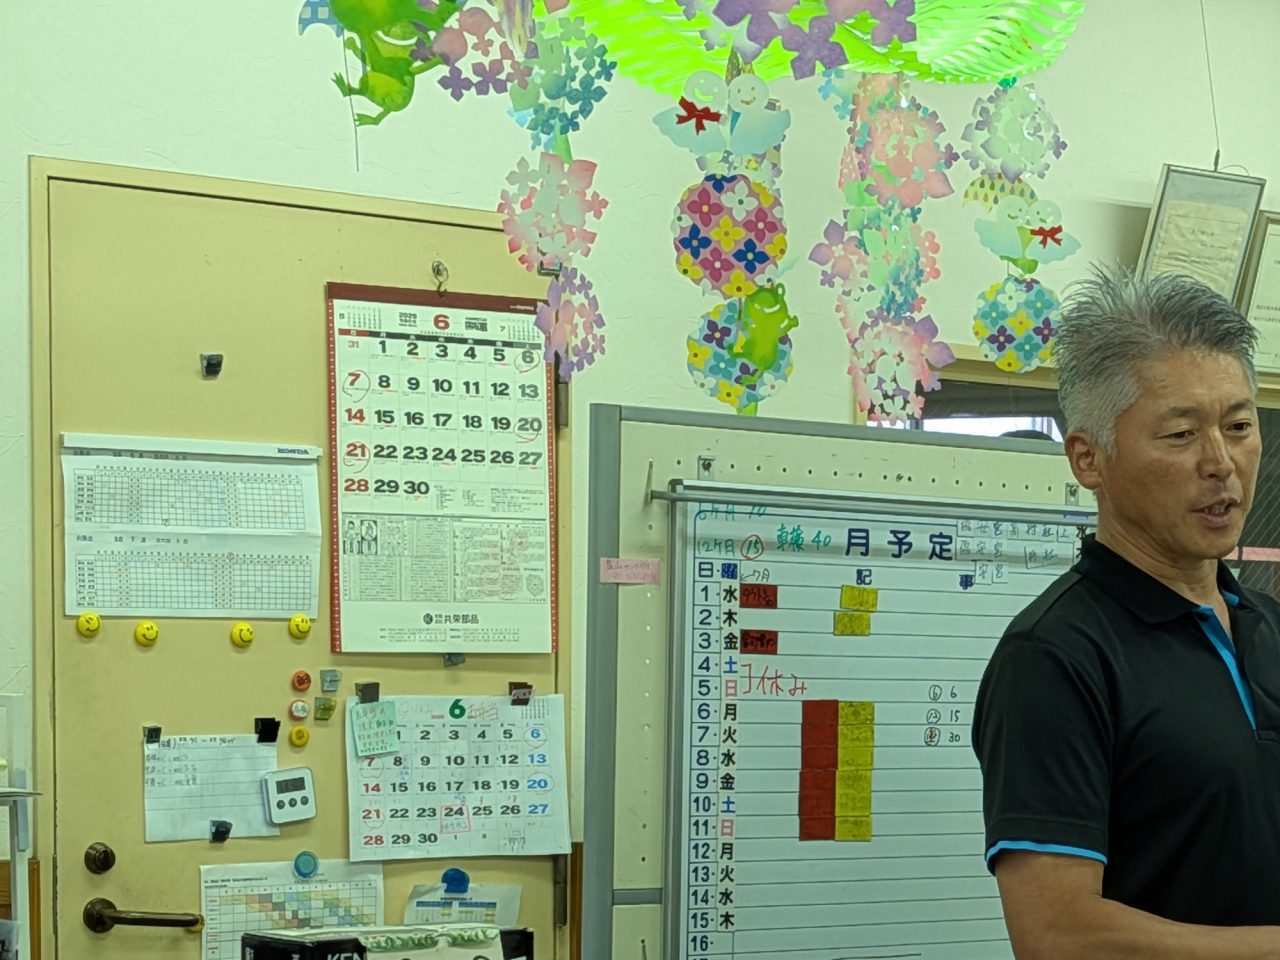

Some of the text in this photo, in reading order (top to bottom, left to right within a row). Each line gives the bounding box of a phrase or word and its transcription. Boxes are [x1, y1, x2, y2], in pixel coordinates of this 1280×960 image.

[434, 314, 450, 330] 6
[348, 341, 505, 362] 31 1 2 3 5
[374, 410, 510, 430] 15 17 19
[344, 479, 430, 495] 28 30
[856, 569, 872, 585] 記
[758, 667, 807, 696] 休み
[449, 699, 465, 719] 6
[420, 730, 486, 740] 2 4
[390, 809, 409, 818] 22
[364, 834, 437, 845] 28 30
